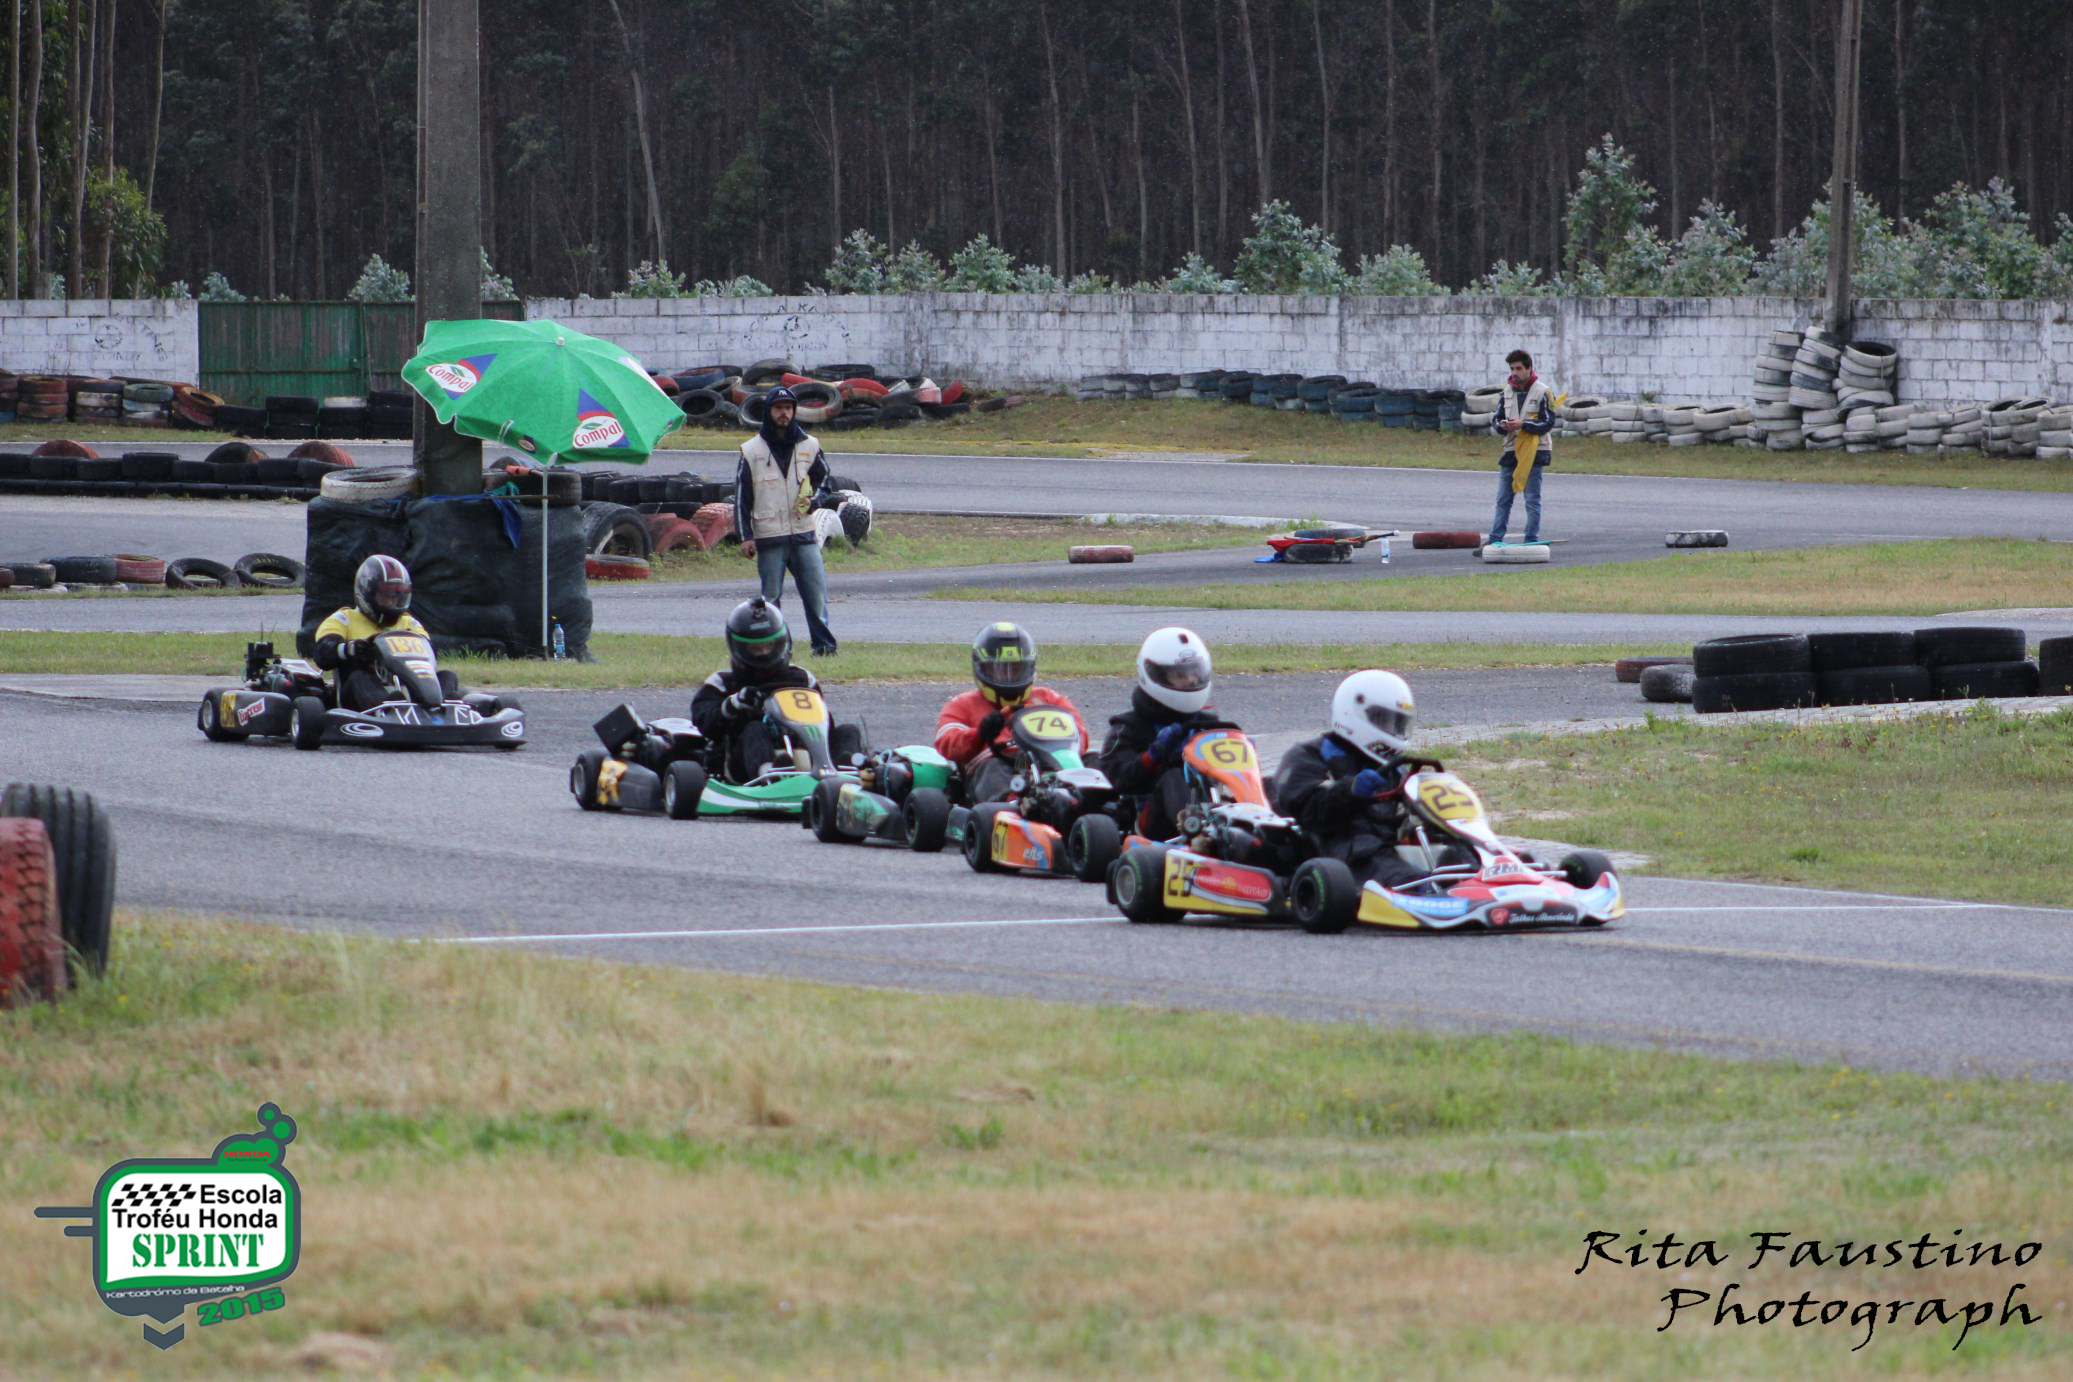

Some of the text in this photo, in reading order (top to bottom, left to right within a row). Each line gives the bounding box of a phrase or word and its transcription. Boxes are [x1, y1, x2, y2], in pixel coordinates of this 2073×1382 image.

[428, 364, 474, 392] Compal
[574, 421, 622, 448] Compal
[387, 637, 425, 654] 136
[791, 691, 812, 710] 8
[1029, 716, 1068, 732] 74
[1211, 741, 1248, 763] 67
[1423, 784, 1474, 811] 25
